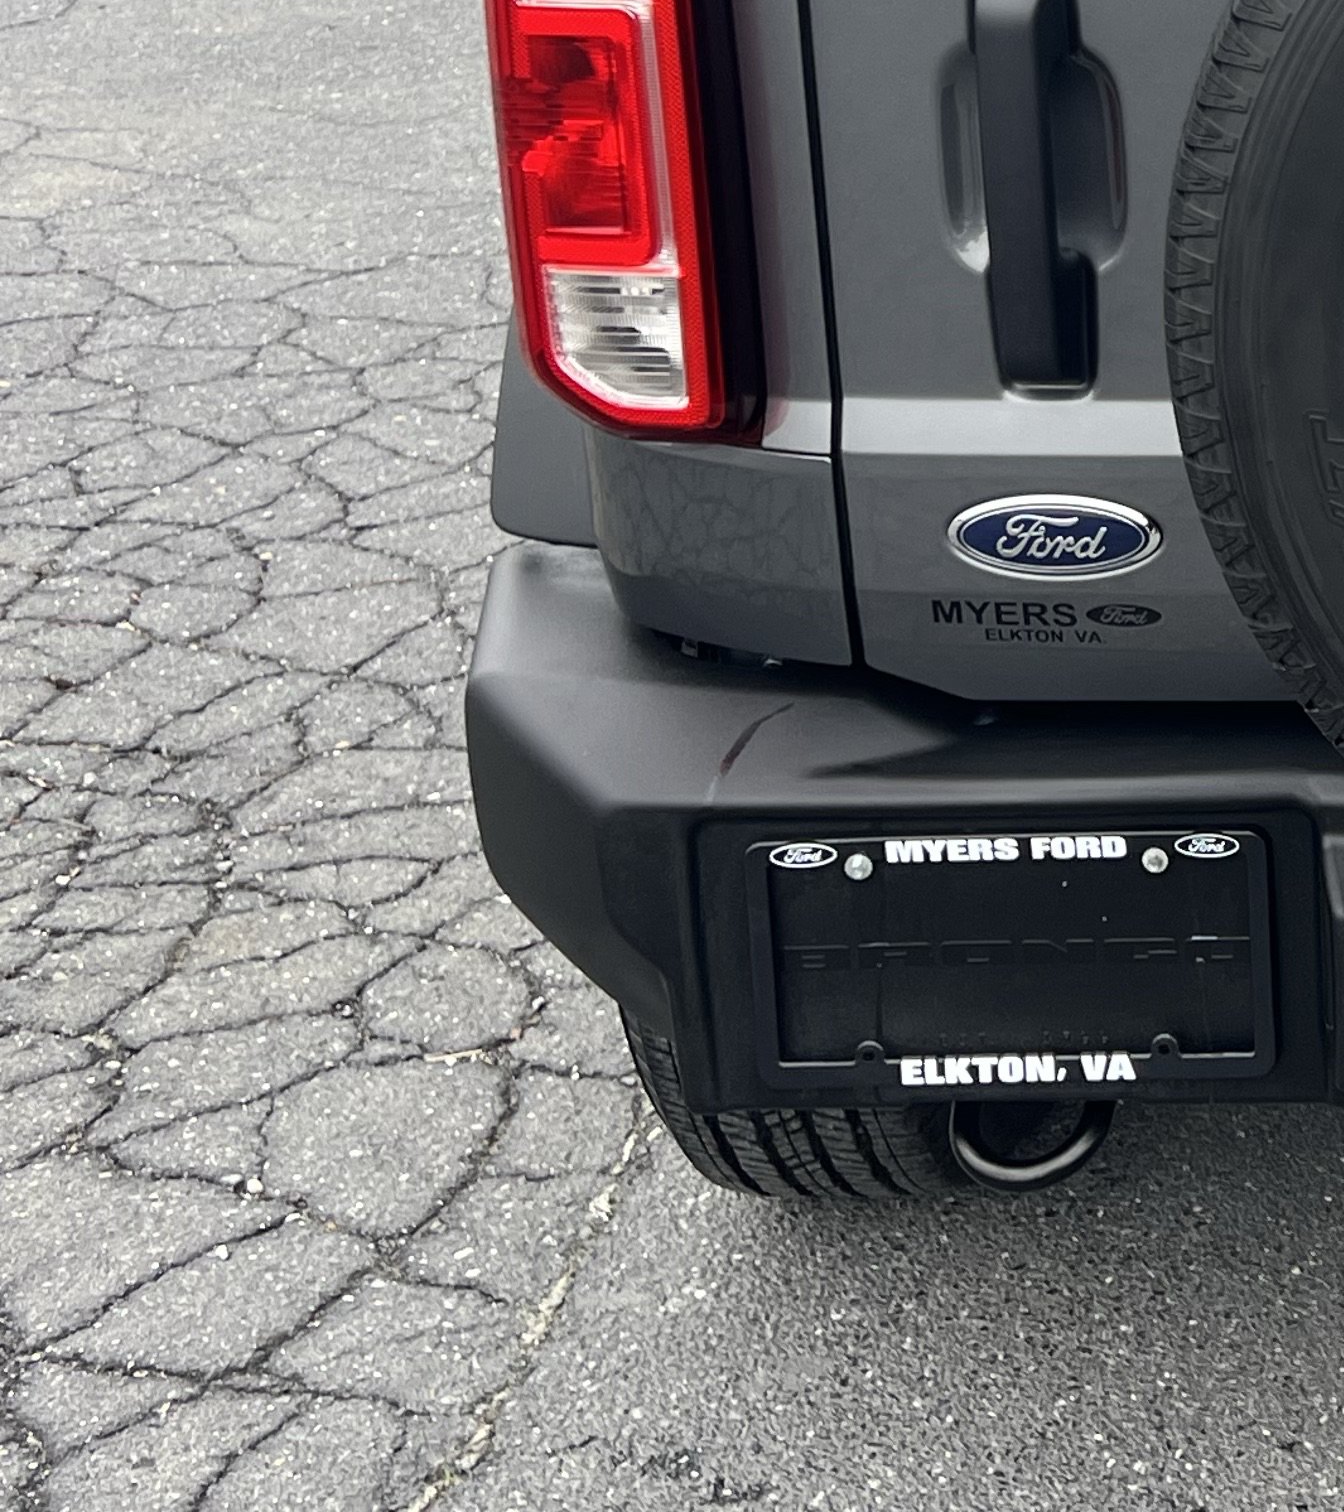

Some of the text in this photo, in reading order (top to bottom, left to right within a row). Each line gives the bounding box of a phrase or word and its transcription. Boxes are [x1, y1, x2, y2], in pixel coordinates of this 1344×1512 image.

[996, 513, 1107, 560] Ford
[931, 599, 1150, 627] MYERS Ford
[985, 628, 1064, 643] ELKTON
[884, 835, 1128, 863] MYERS FORD
[900, 1051, 1137, 1087] ELKTON, VA
